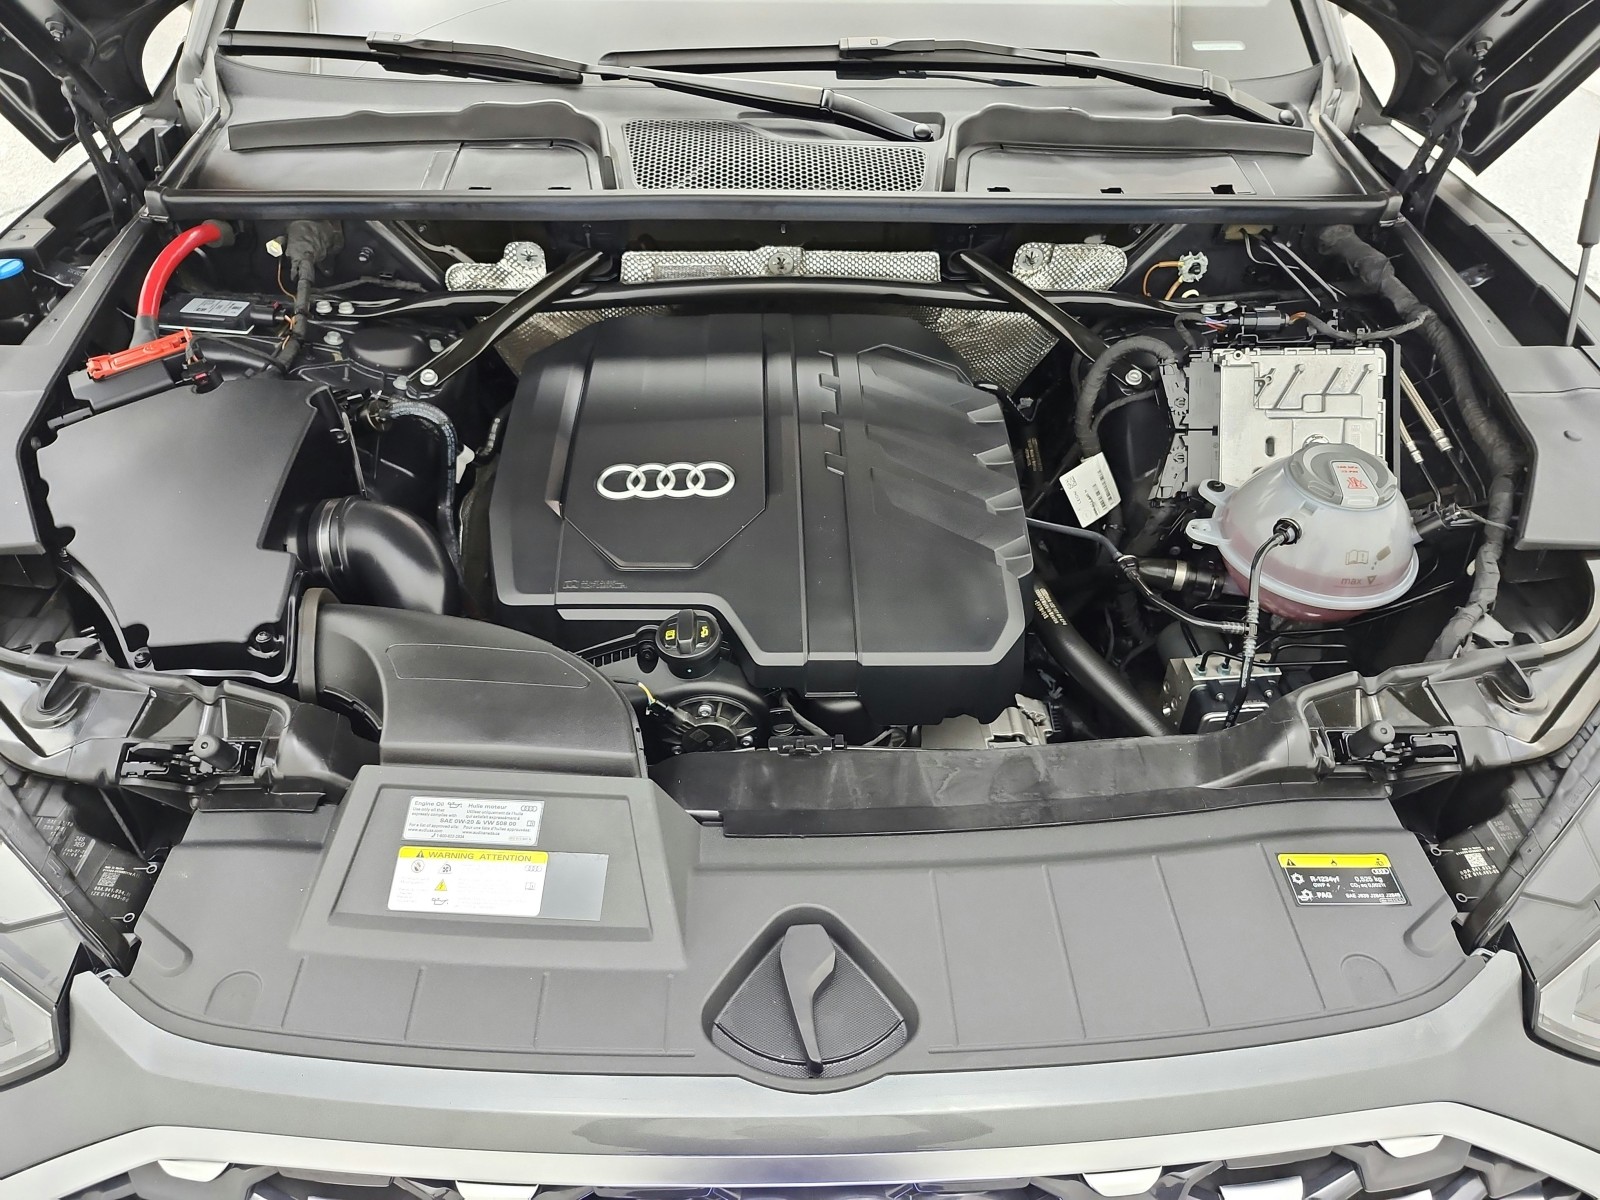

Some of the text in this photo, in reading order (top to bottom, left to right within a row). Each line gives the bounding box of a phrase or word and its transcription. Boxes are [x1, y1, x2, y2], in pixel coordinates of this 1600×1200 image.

[1341, 577, 1362, 585] max
[428, 851, 532, 862] WARNING ATTENTION
[1310, 876, 1340, 884] R-1234yf
